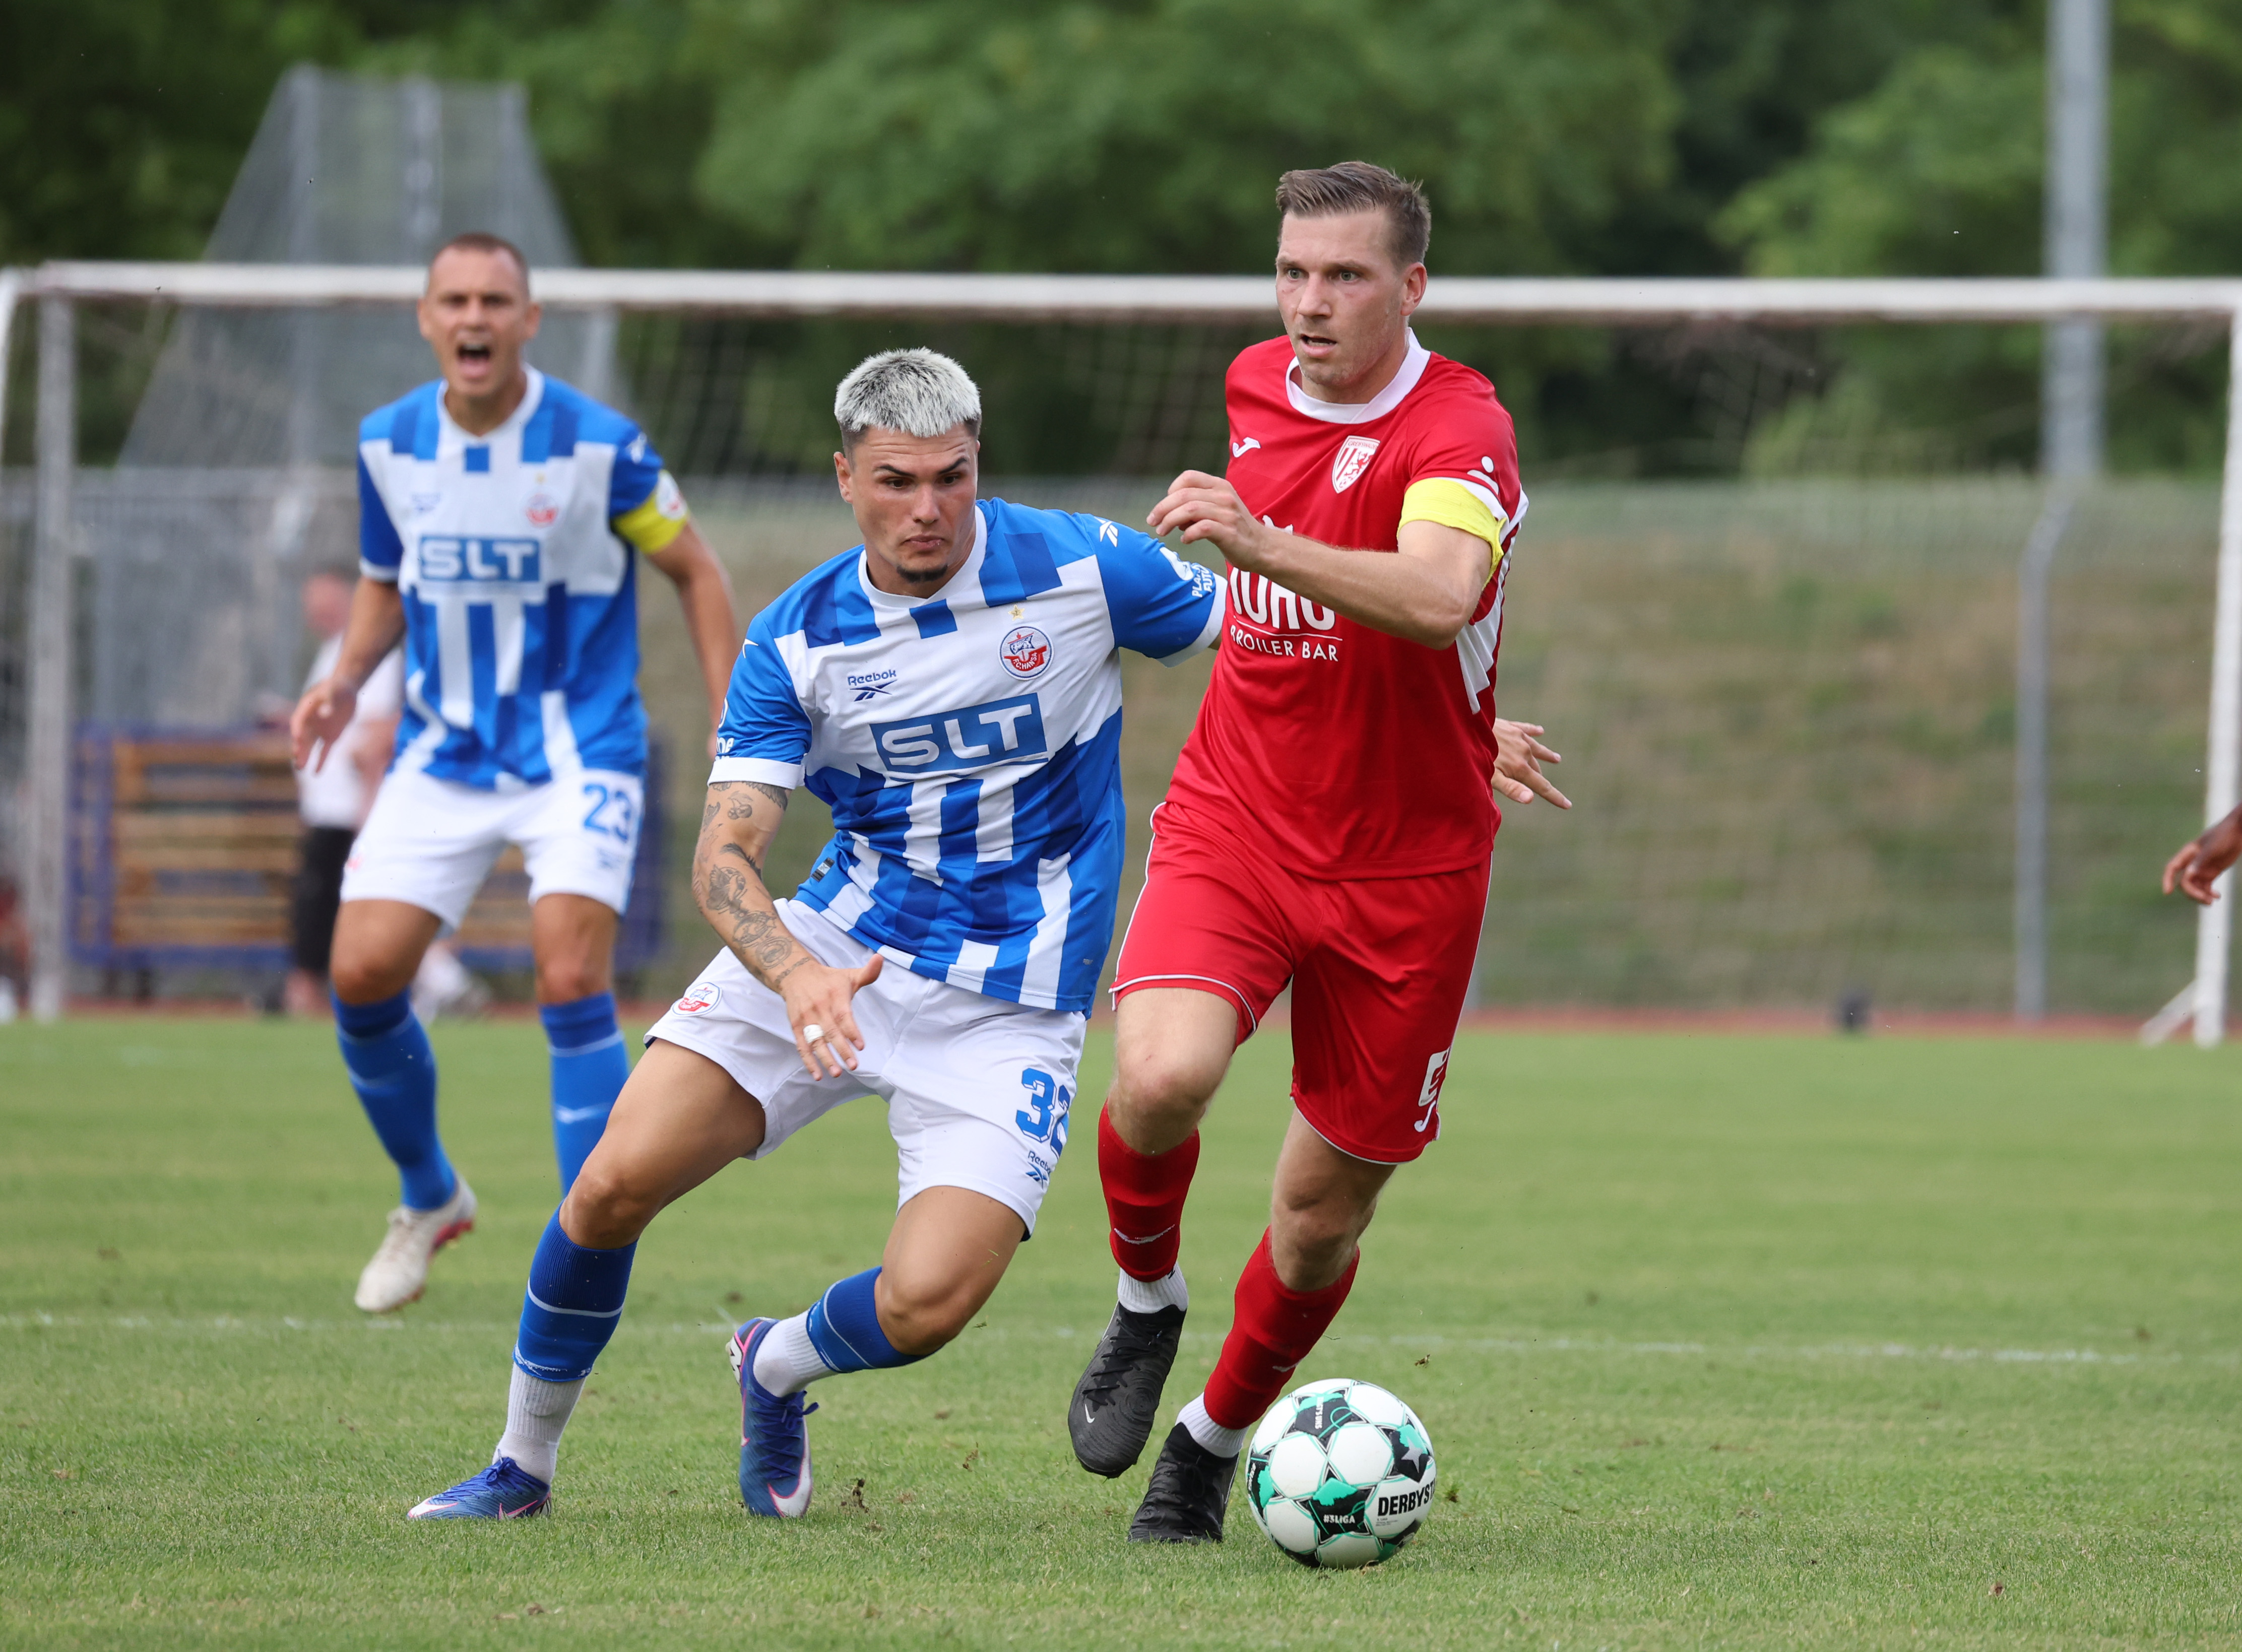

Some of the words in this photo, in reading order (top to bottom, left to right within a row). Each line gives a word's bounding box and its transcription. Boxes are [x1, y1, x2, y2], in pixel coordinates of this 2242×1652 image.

[423, 540, 535, 579] SLT
[1302, 641, 1338, 662] BAR
[847, 669, 896, 686] Reebok
[882, 704, 1032, 766] SLT
[583, 782, 631, 843] 23
[1377, 1478, 1435, 1516] DERBYST
[1323, 1514, 1356, 1524] #3LIGA
